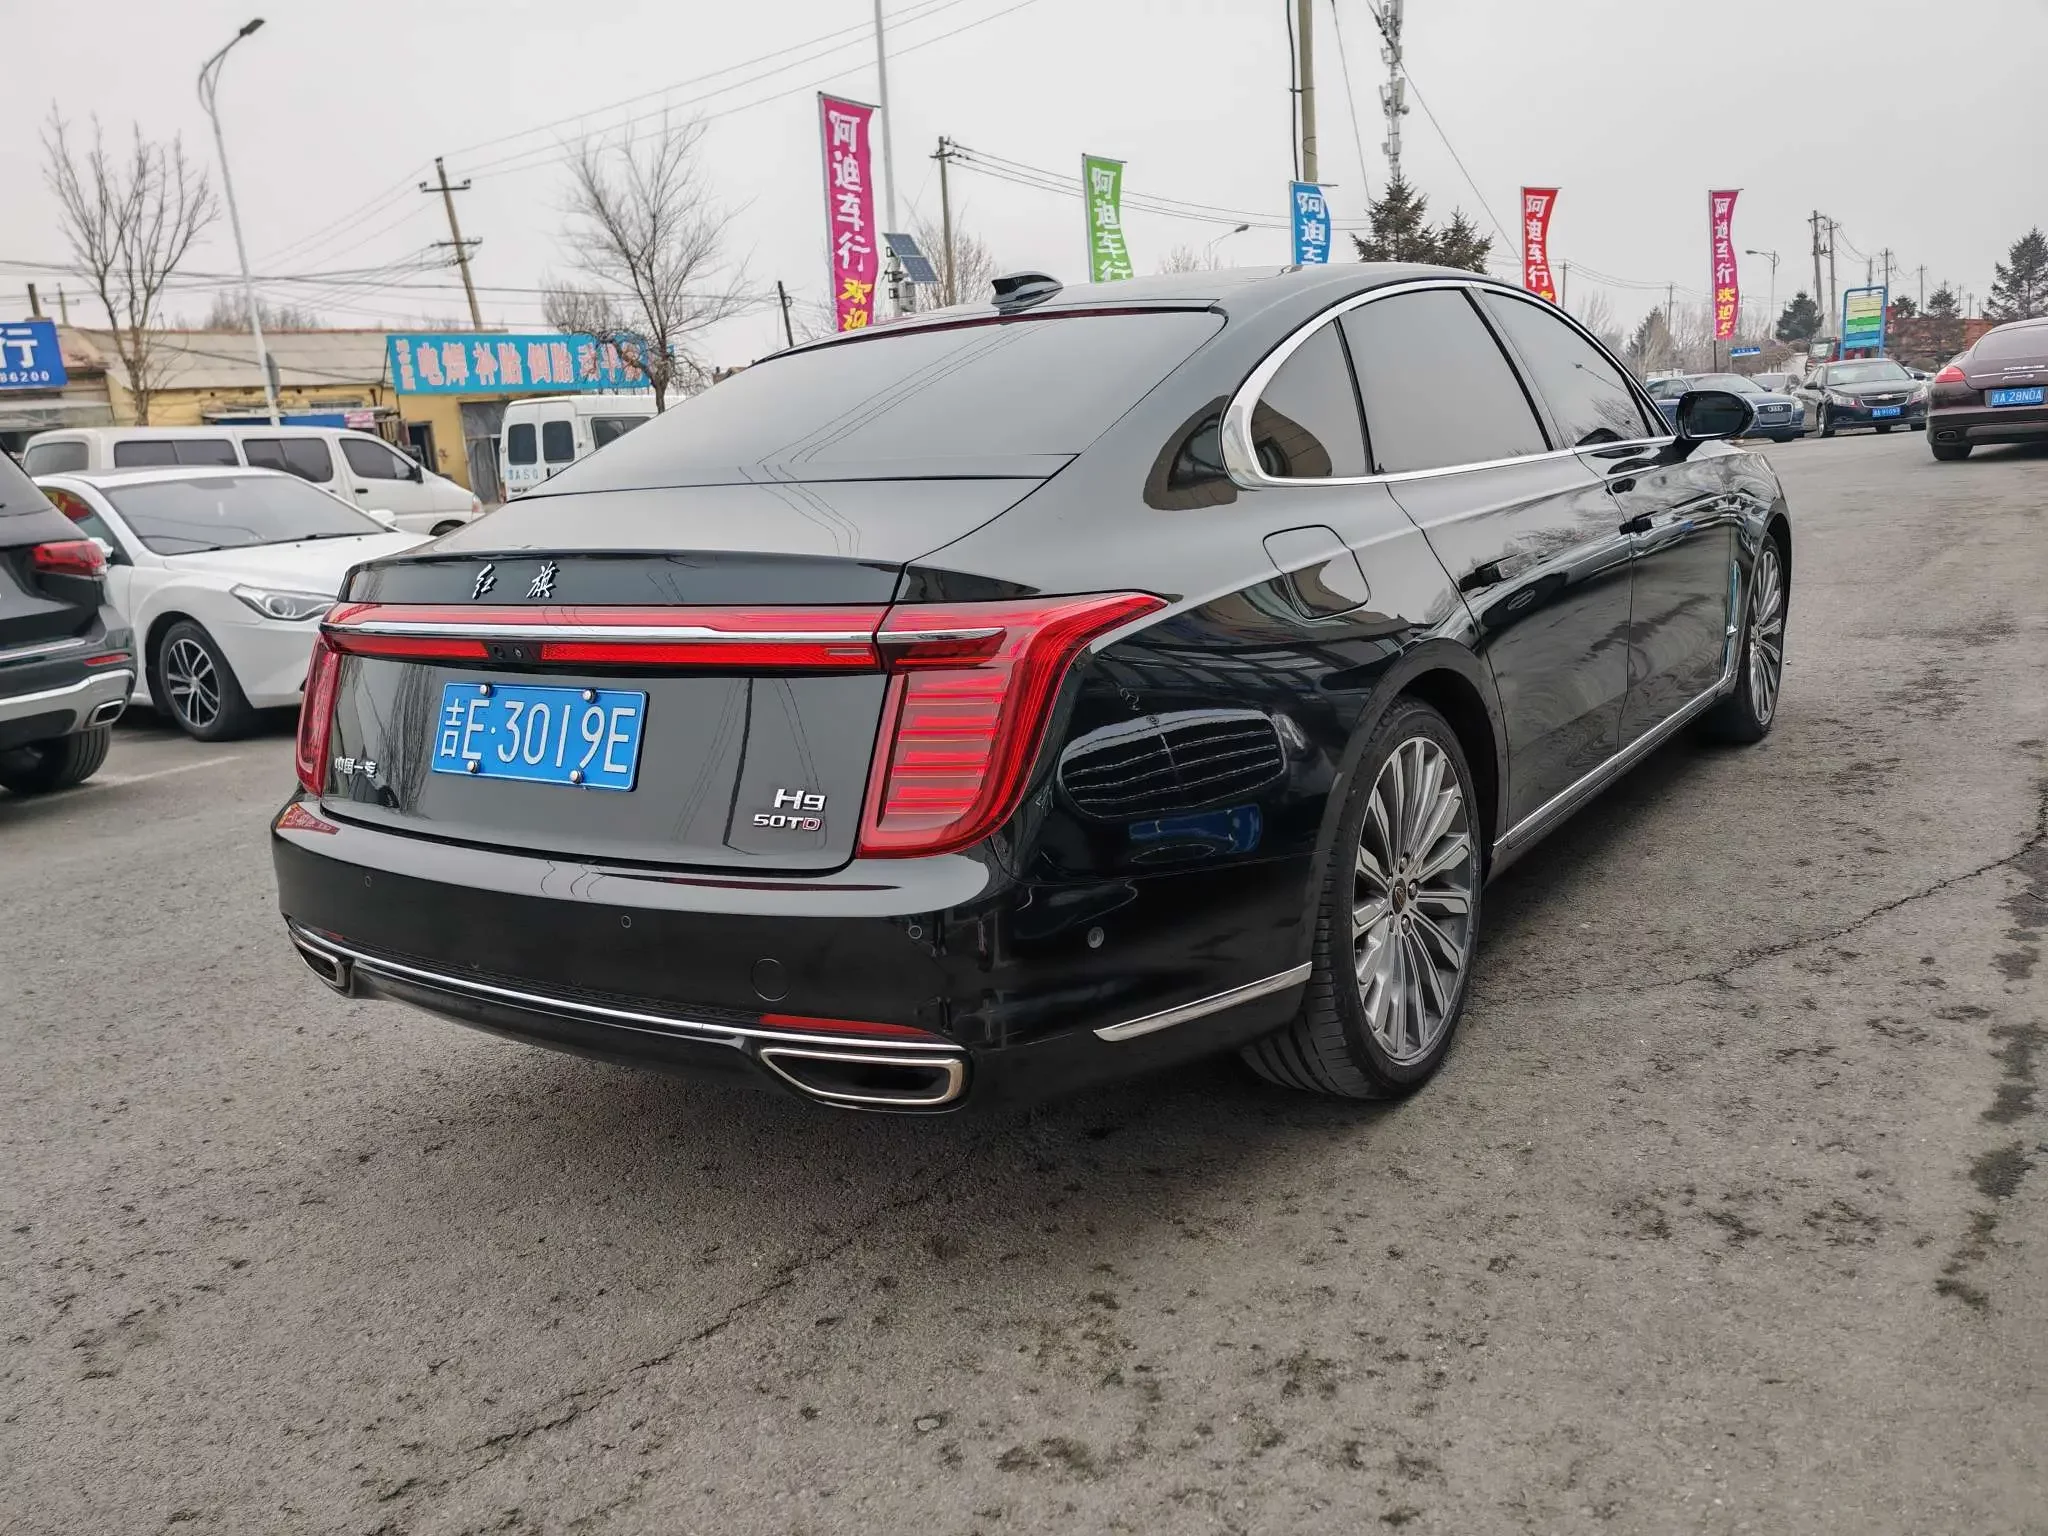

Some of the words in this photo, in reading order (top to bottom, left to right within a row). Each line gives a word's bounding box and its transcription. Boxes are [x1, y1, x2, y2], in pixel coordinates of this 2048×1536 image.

[472, 561, 556, 599] 红旗
[335, 757, 377, 778] 中国一汽
[774, 788, 826, 811] H9
